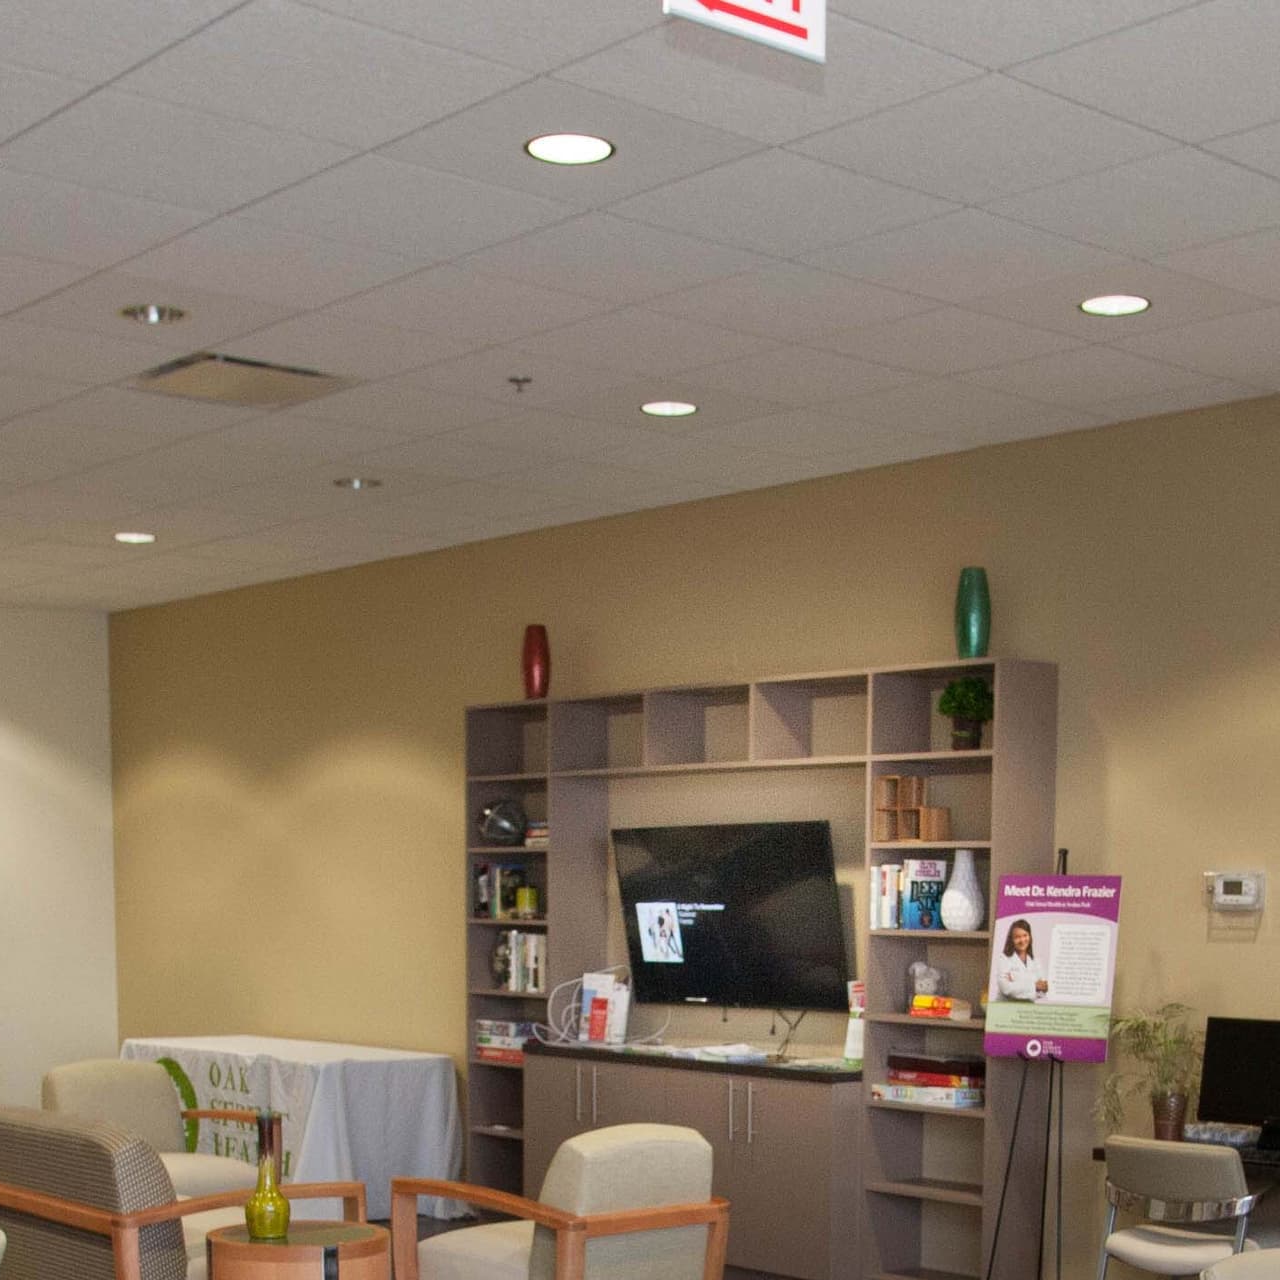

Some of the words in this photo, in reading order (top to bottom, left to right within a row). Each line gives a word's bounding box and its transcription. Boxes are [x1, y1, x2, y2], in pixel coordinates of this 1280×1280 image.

[1004, 884, 1030, 897] Meet
[1031, 884, 1045, 897] Dr.
[1046, 885, 1081, 898] Kendra
[1082, 885, 1116, 898] Frazier
[209, 1062, 249, 1094] OAK
